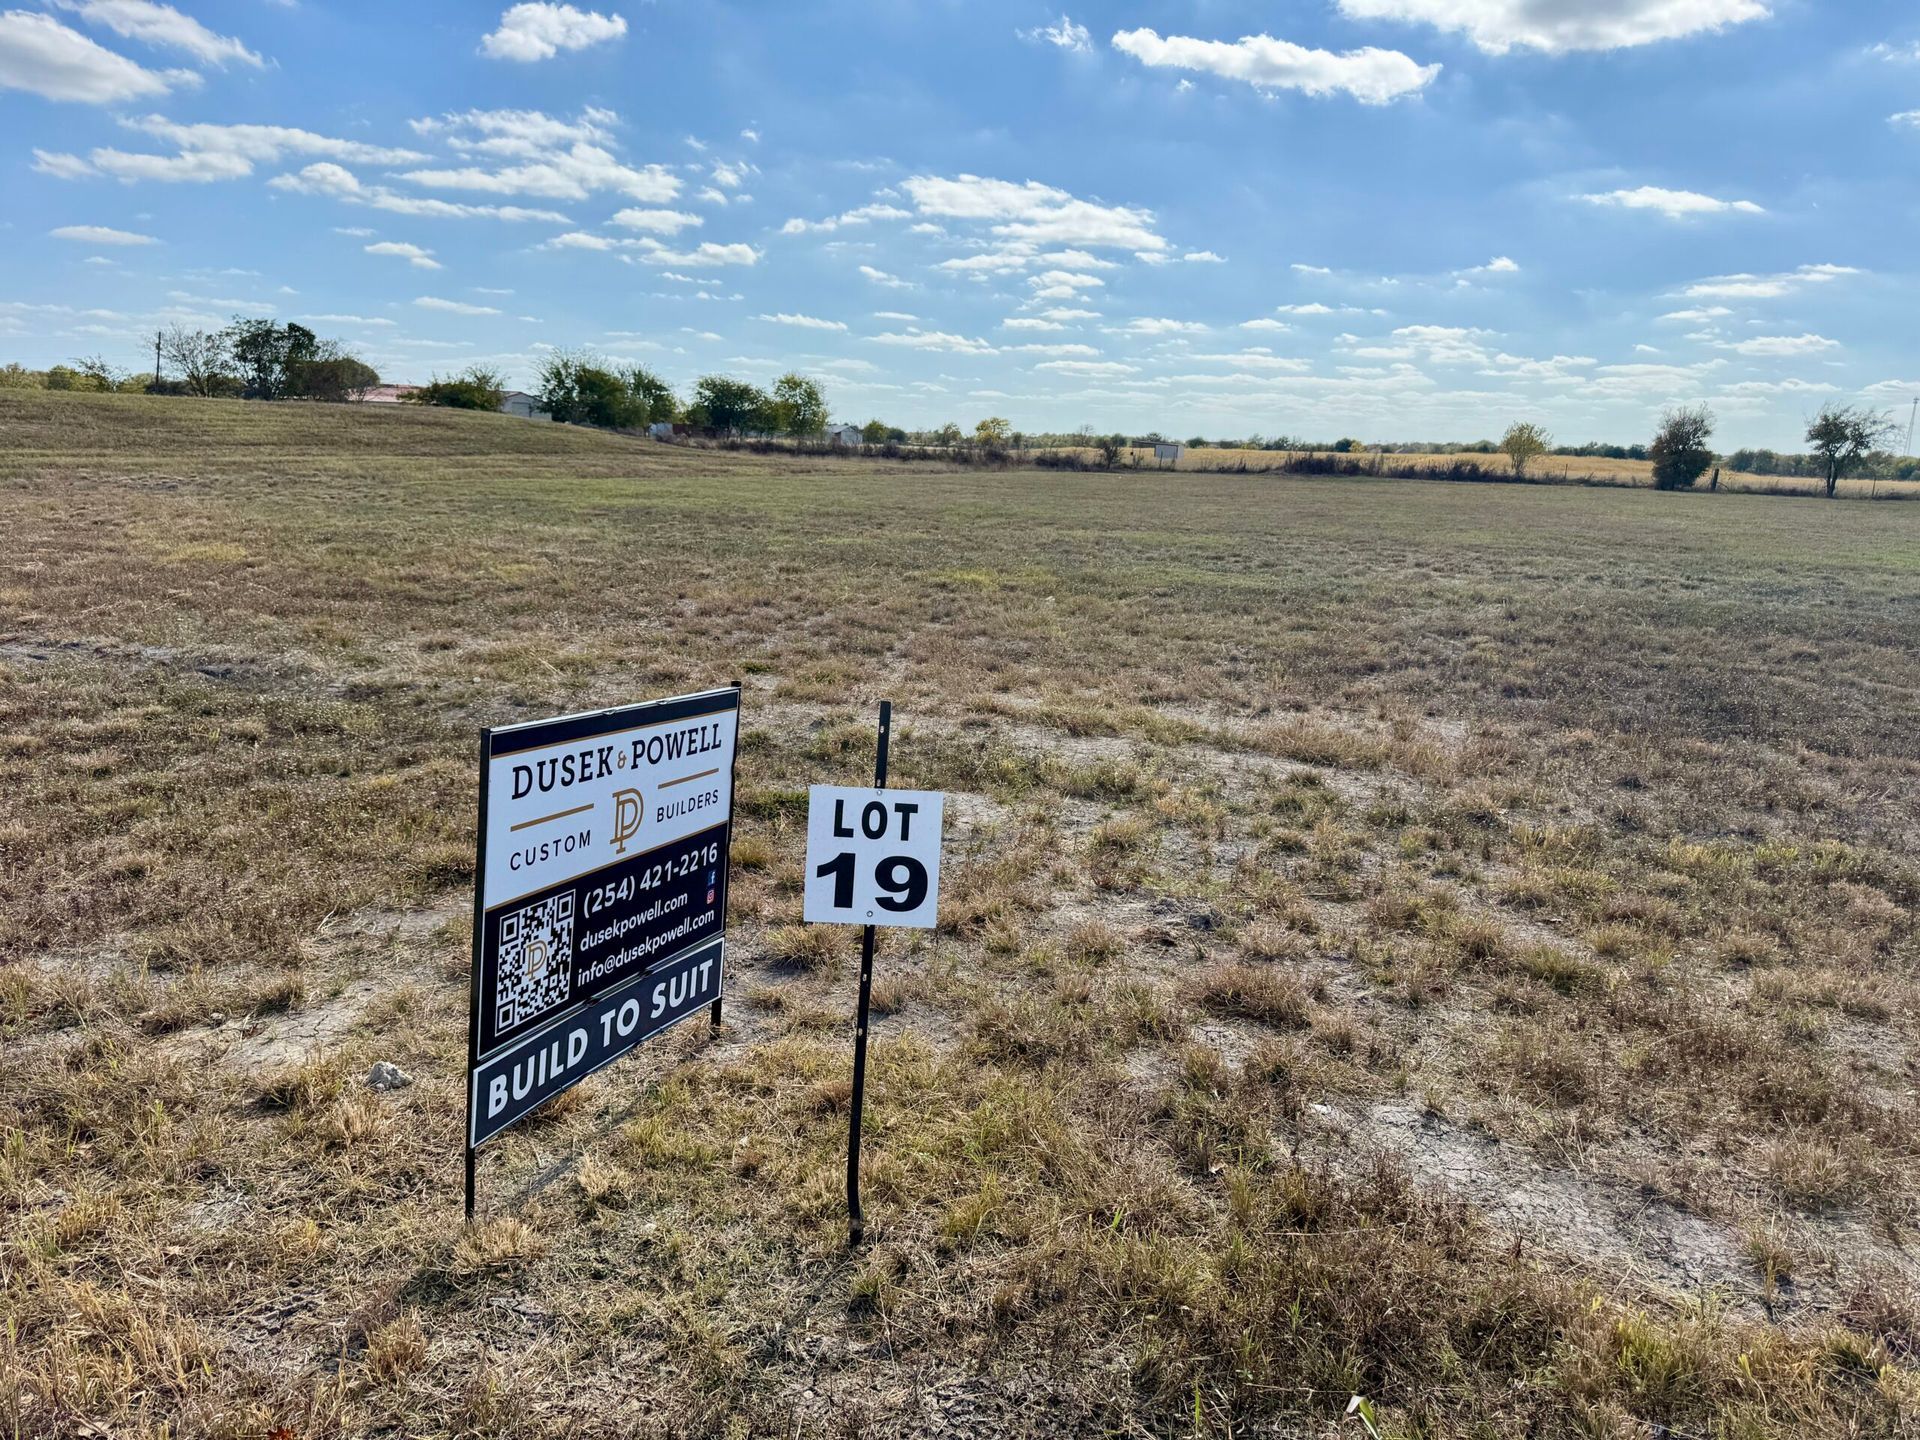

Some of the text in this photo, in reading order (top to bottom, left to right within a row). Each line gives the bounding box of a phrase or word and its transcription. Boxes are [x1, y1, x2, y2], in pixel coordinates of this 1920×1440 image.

[511, 723, 722, 800] DUSEK & POWELL
[656, 789, 719, 823] BUILDERS
[833, 799, 918, 841] LOT
[510, 829, 591, 871] CUSTOM
[583, 842, 718, 919] (254) 421-2216
[816, 852, 928, 913] 19
[577, 908, 715, 987] info@dusekpowell.com
[579, 891, 688, 951] dusekpowell.com
[487, 958, 714, 1119] BUILD TO SUIT
